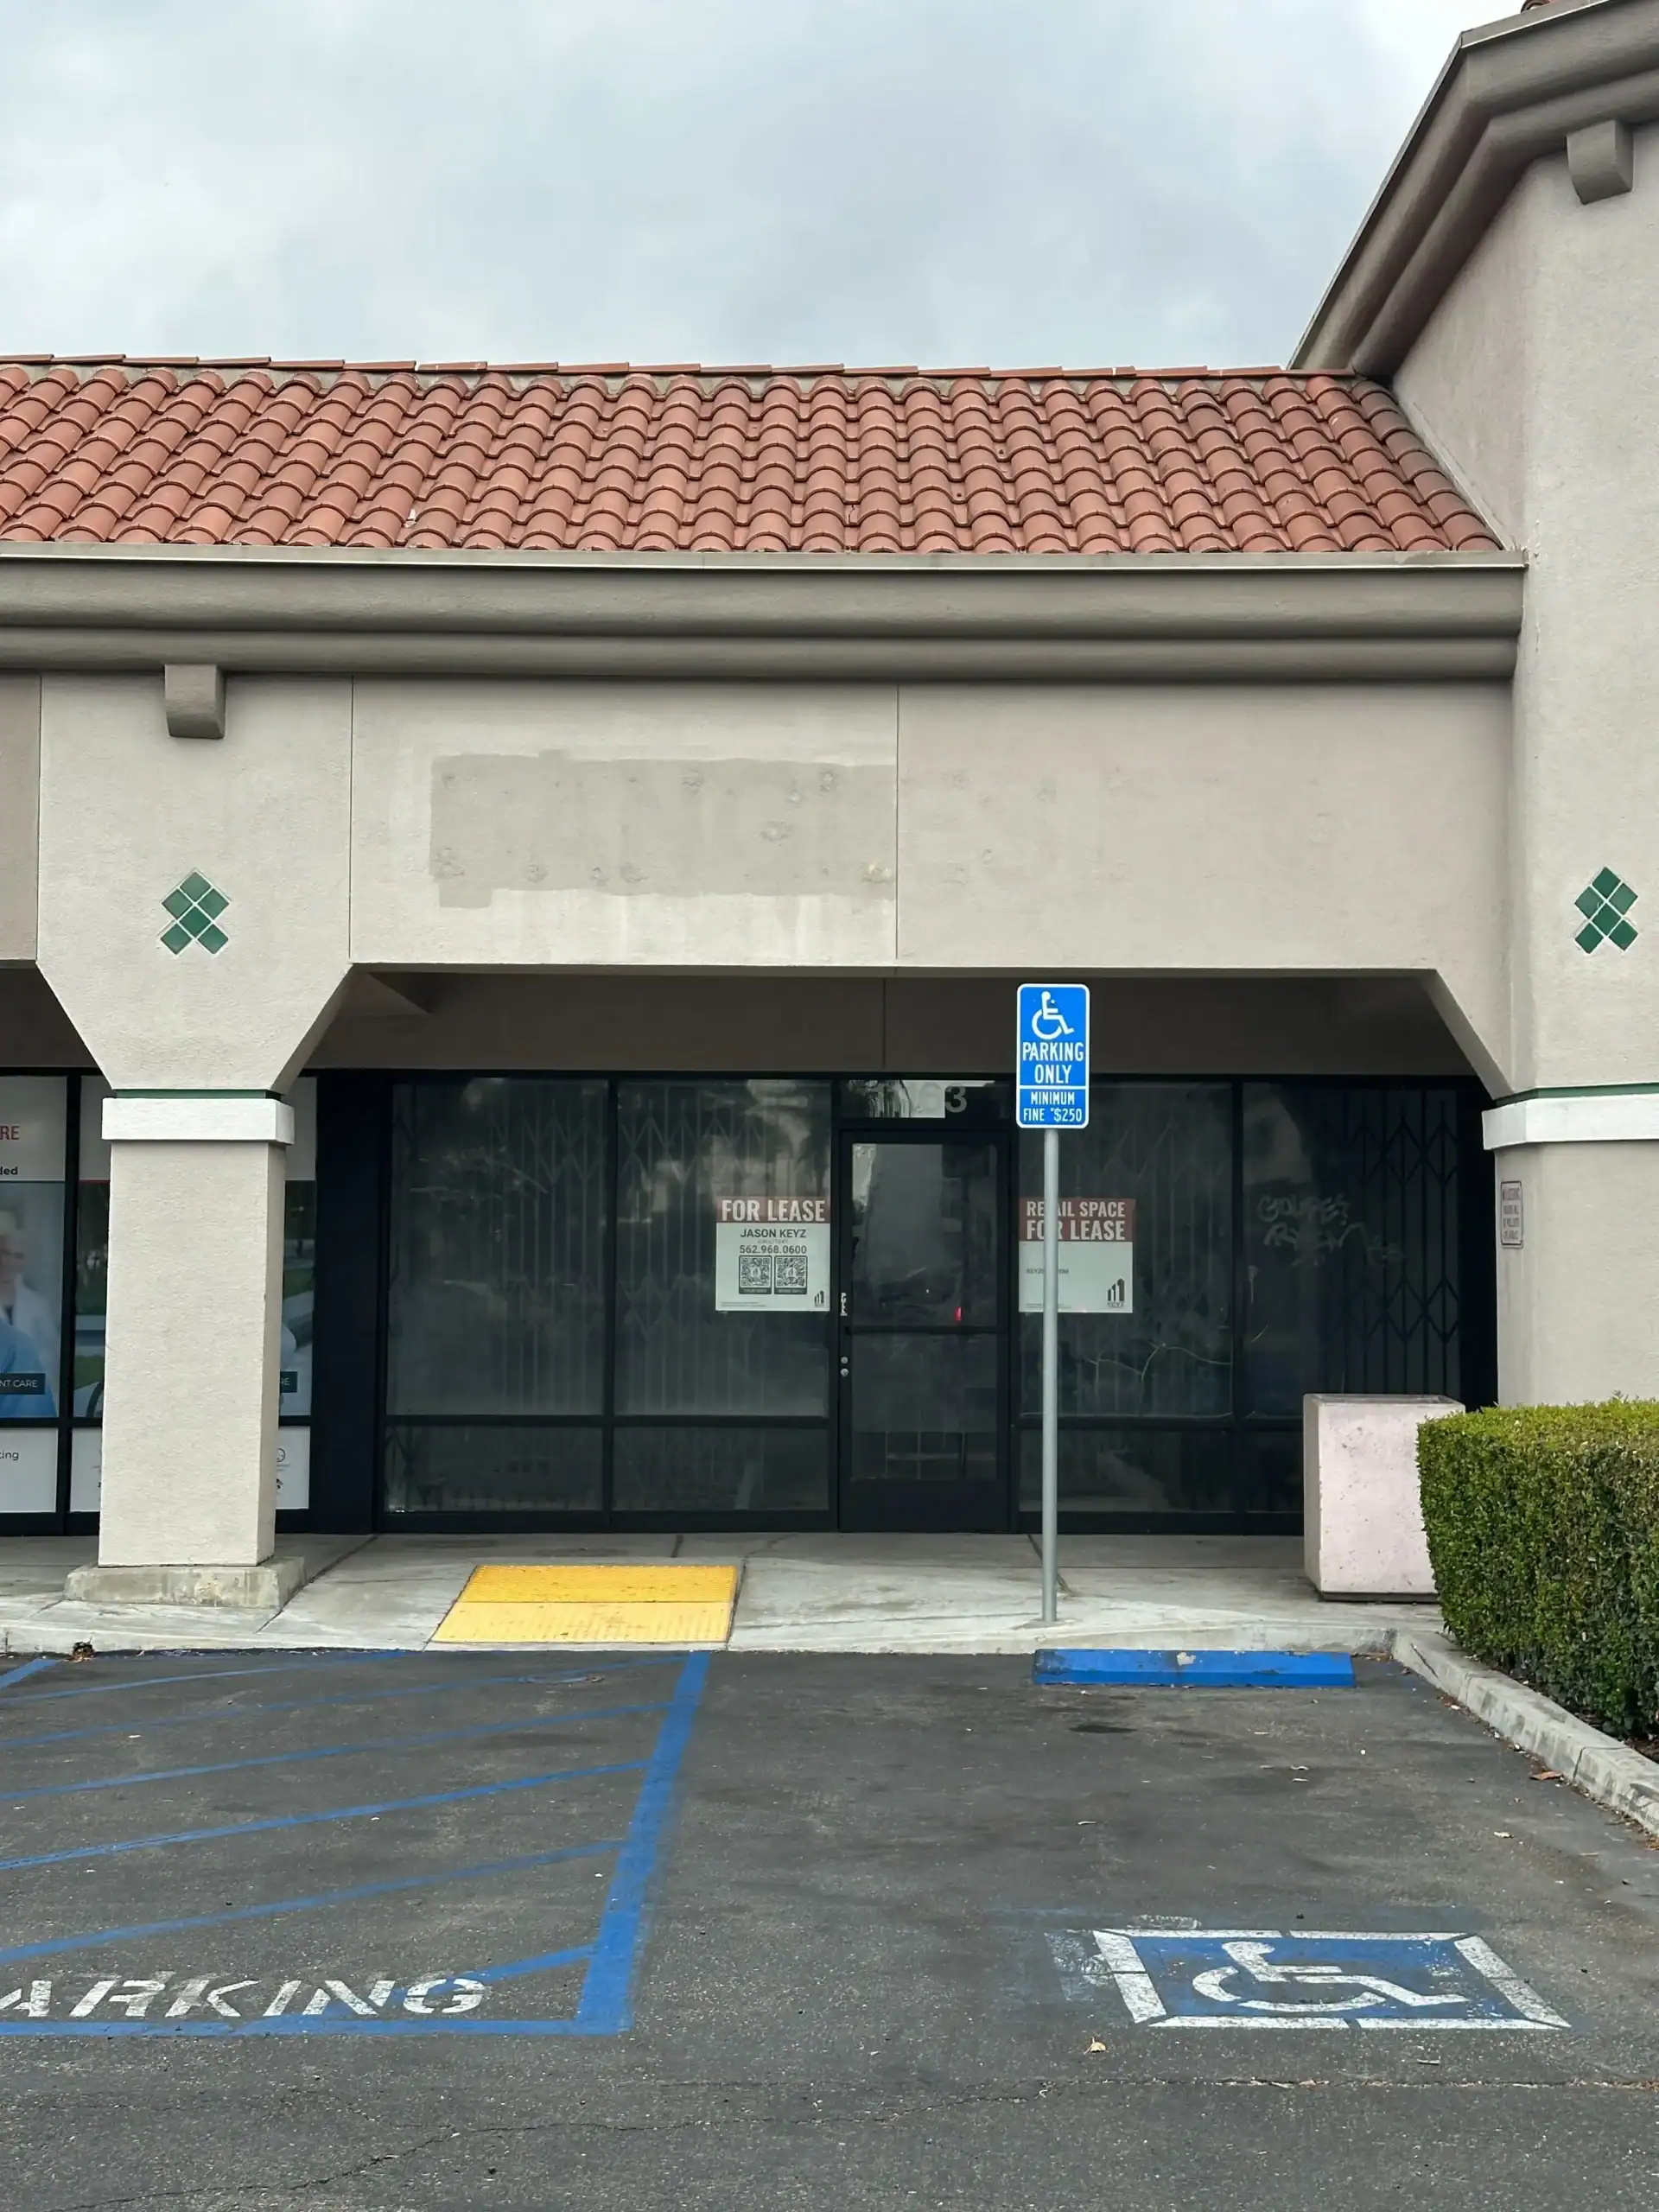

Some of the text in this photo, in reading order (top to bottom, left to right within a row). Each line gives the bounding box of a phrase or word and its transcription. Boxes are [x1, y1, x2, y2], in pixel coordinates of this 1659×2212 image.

[1022, 1042, 1084, 1062] PARKING
[1034, 1064, 1071, 1084] ONLY
[1031, 1091, 1075, 1105] MINIMUM
[1023, 1108, 1045, 1122] FINE
[721, 1199, 825, 1222] FOR LEASE
[1079, 1201, 1126, 1217] SPACE
[740, 1228, 807, 1238] JASON KEYZ
[1071, 1220, 1125, 1241] LEASE
[739, 1244, 807, 1255] 562.968.0600
[13, 1379, 38, 1388] CARE
[0, 1977, 483, 2017] ARKING
